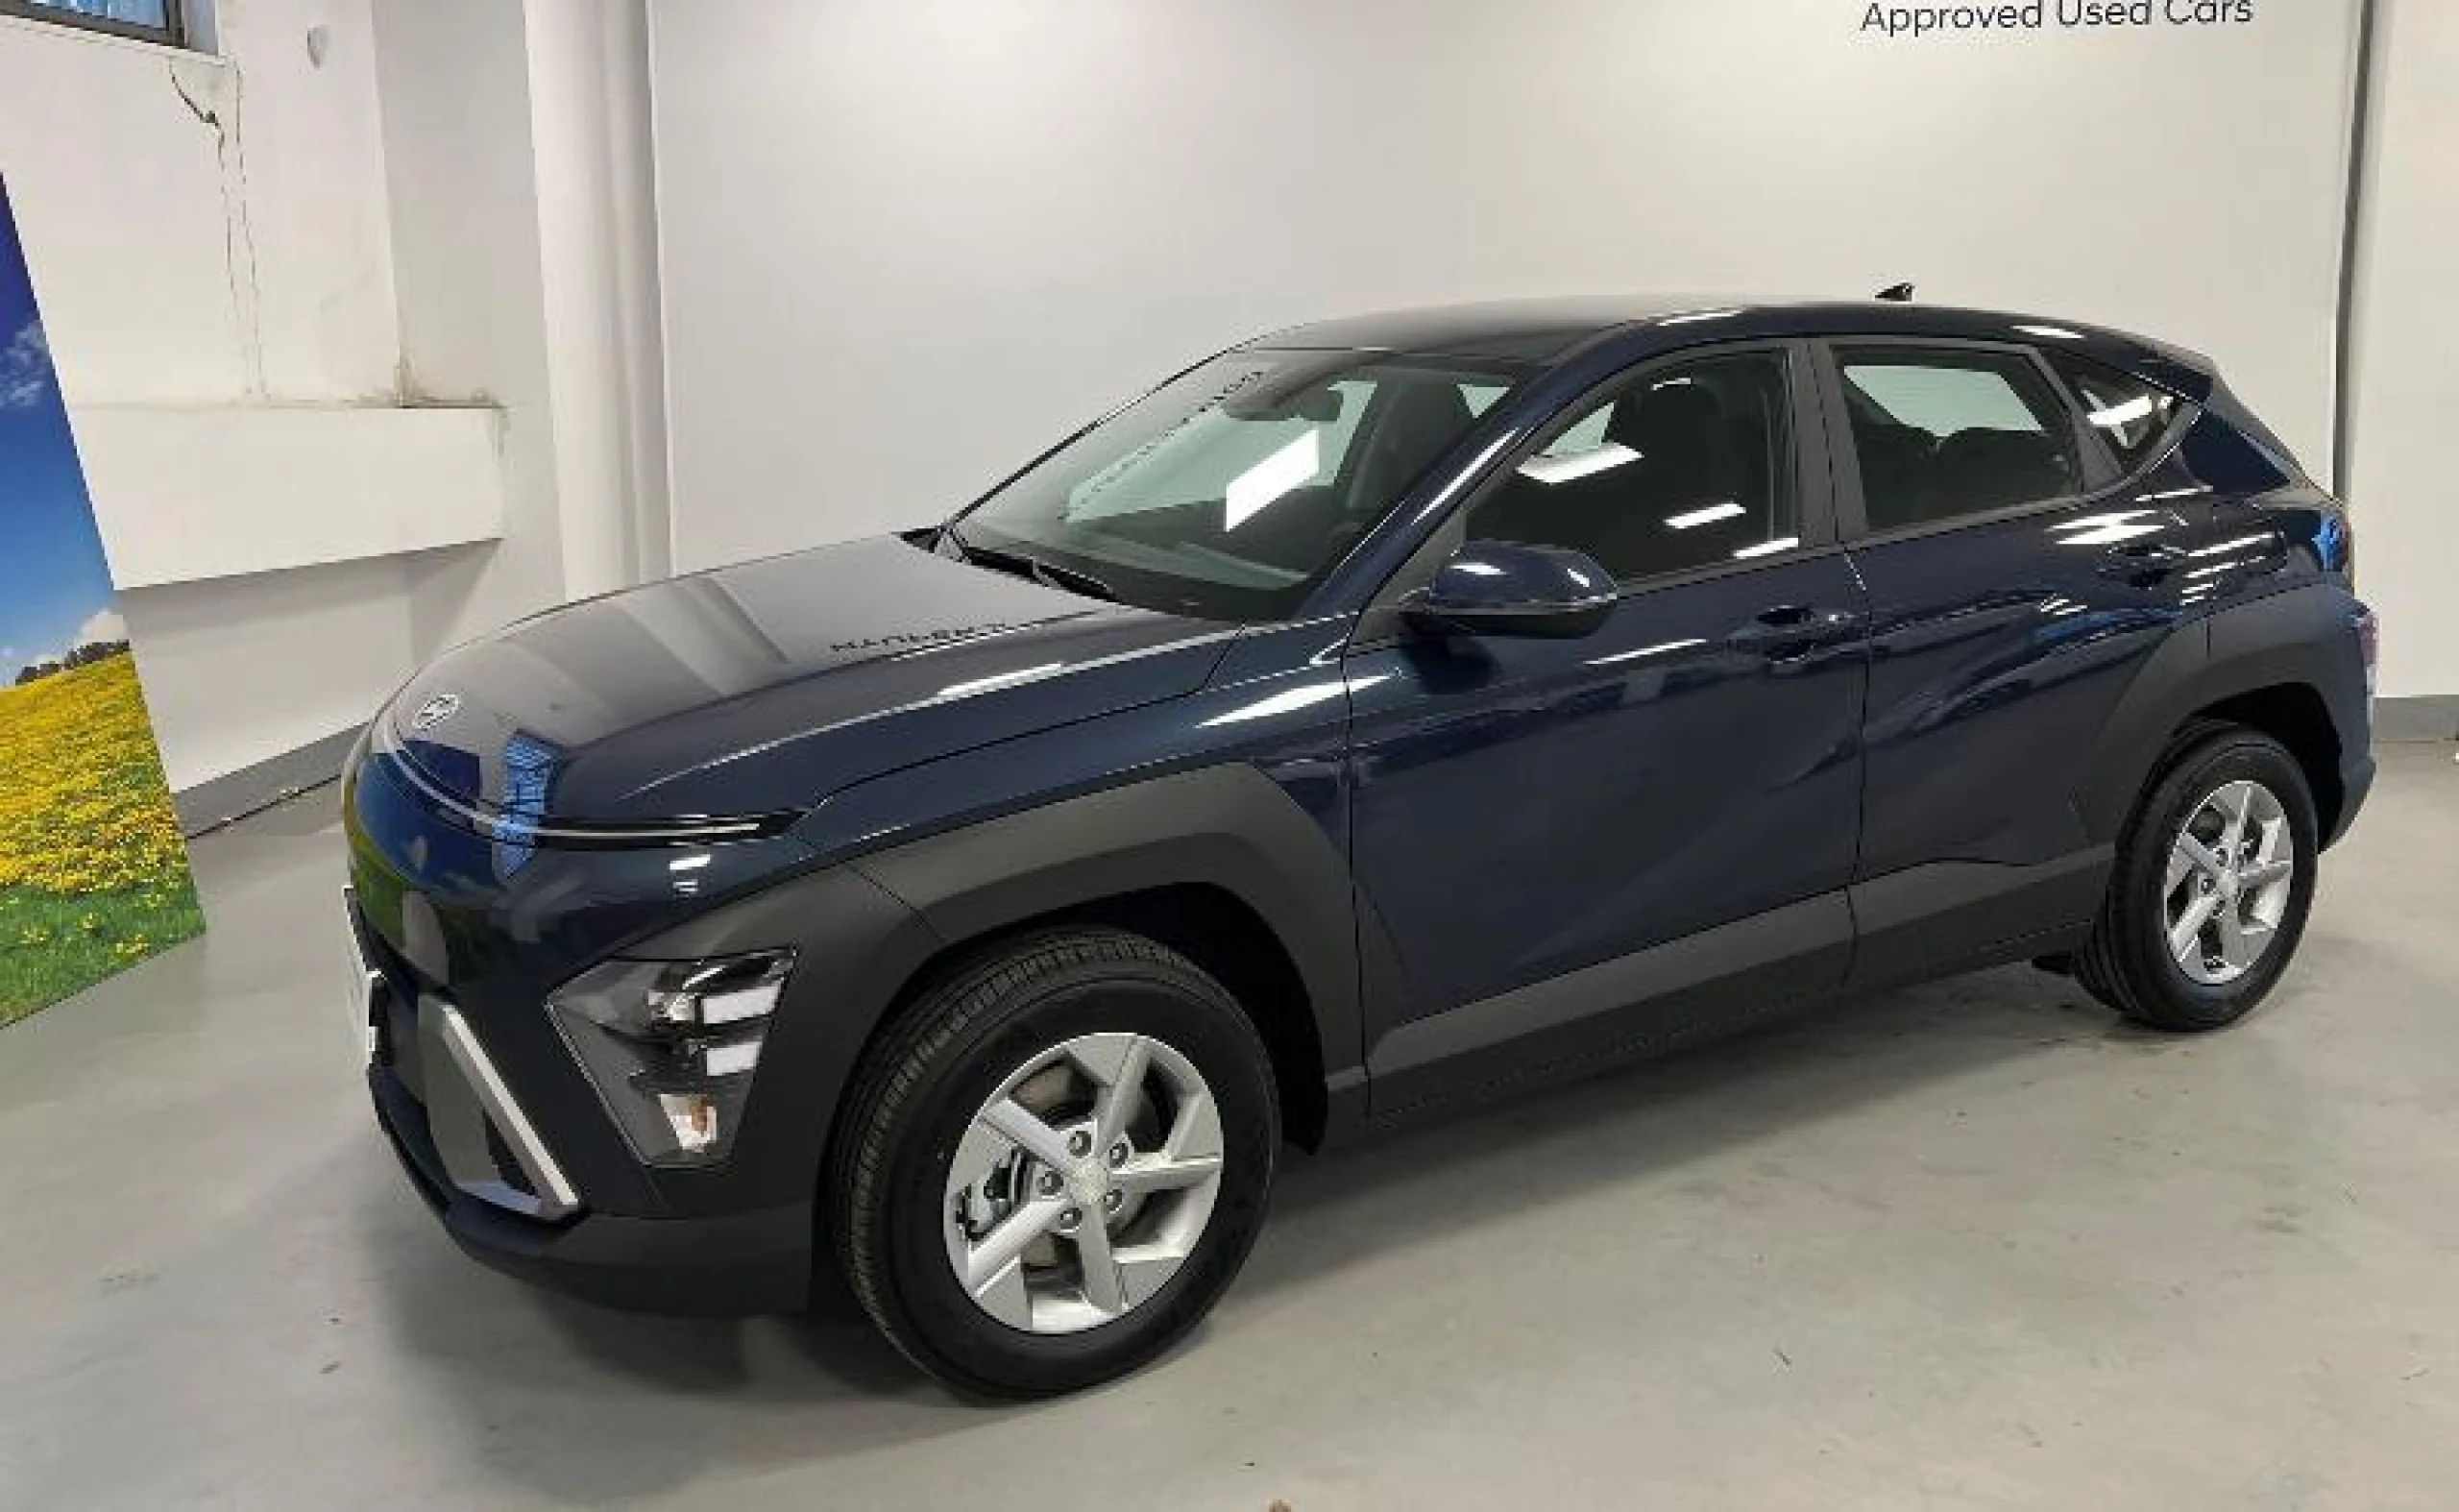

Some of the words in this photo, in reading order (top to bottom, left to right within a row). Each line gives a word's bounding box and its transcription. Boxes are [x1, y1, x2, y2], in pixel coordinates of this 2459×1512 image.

[1860, 0, 2042, 37] Approved
[2057, 0, 2151, 26] Used
[2165, 0, 2253, 24] Cars
